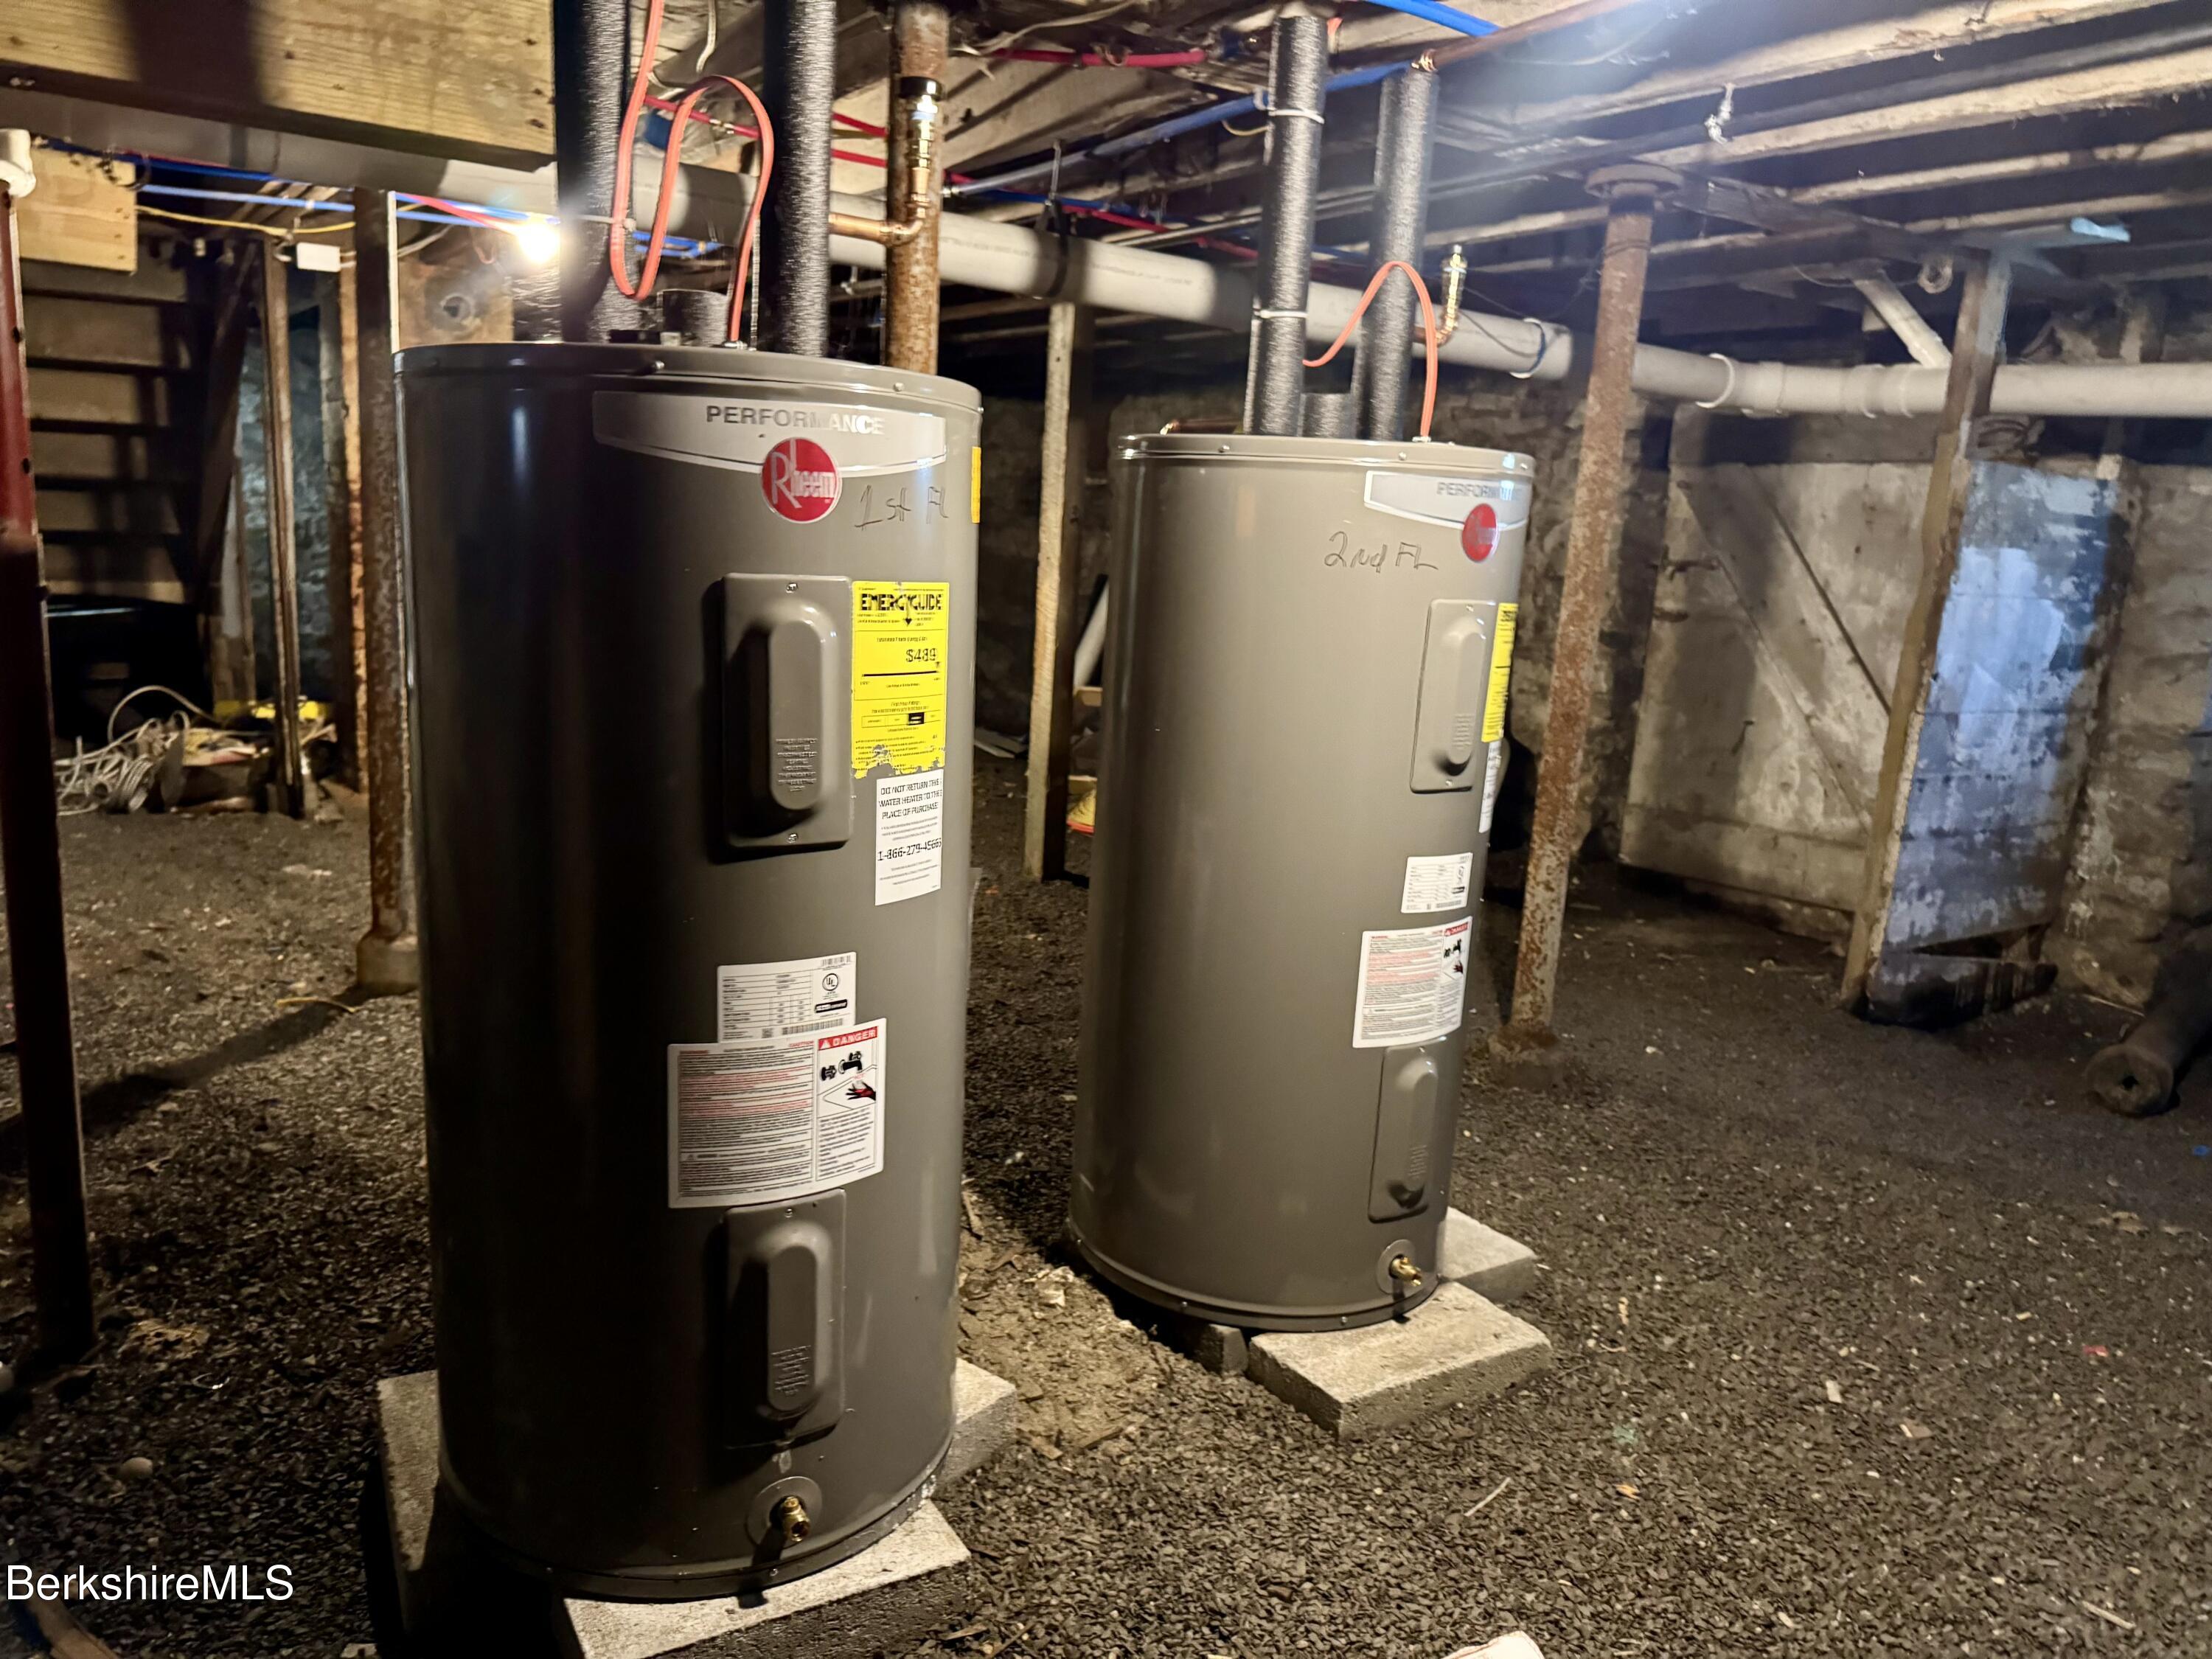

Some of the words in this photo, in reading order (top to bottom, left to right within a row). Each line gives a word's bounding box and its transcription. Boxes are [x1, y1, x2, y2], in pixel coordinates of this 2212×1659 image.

[706, 405, 885, 435] PERFORMANCE
[771, 437, 835, 509] Rheem
[855, 484, 911, 531] 1st
[1324, 530, 1387, 574] 2nd
[1395, 541, 1439, 570] FL
[880, 787, 891, 796] DO
[891, 785, 906, 793] NOT
[906, 781, 928, 791] RETURN
[878, 797, 901, 807] WATER
[882, 809, 902, 820] PLACE
[902, 807, 911, 816] OF
[911, 801, 939, 815] PURCHASE
[832, 1029, 876, 1046] DANGER
